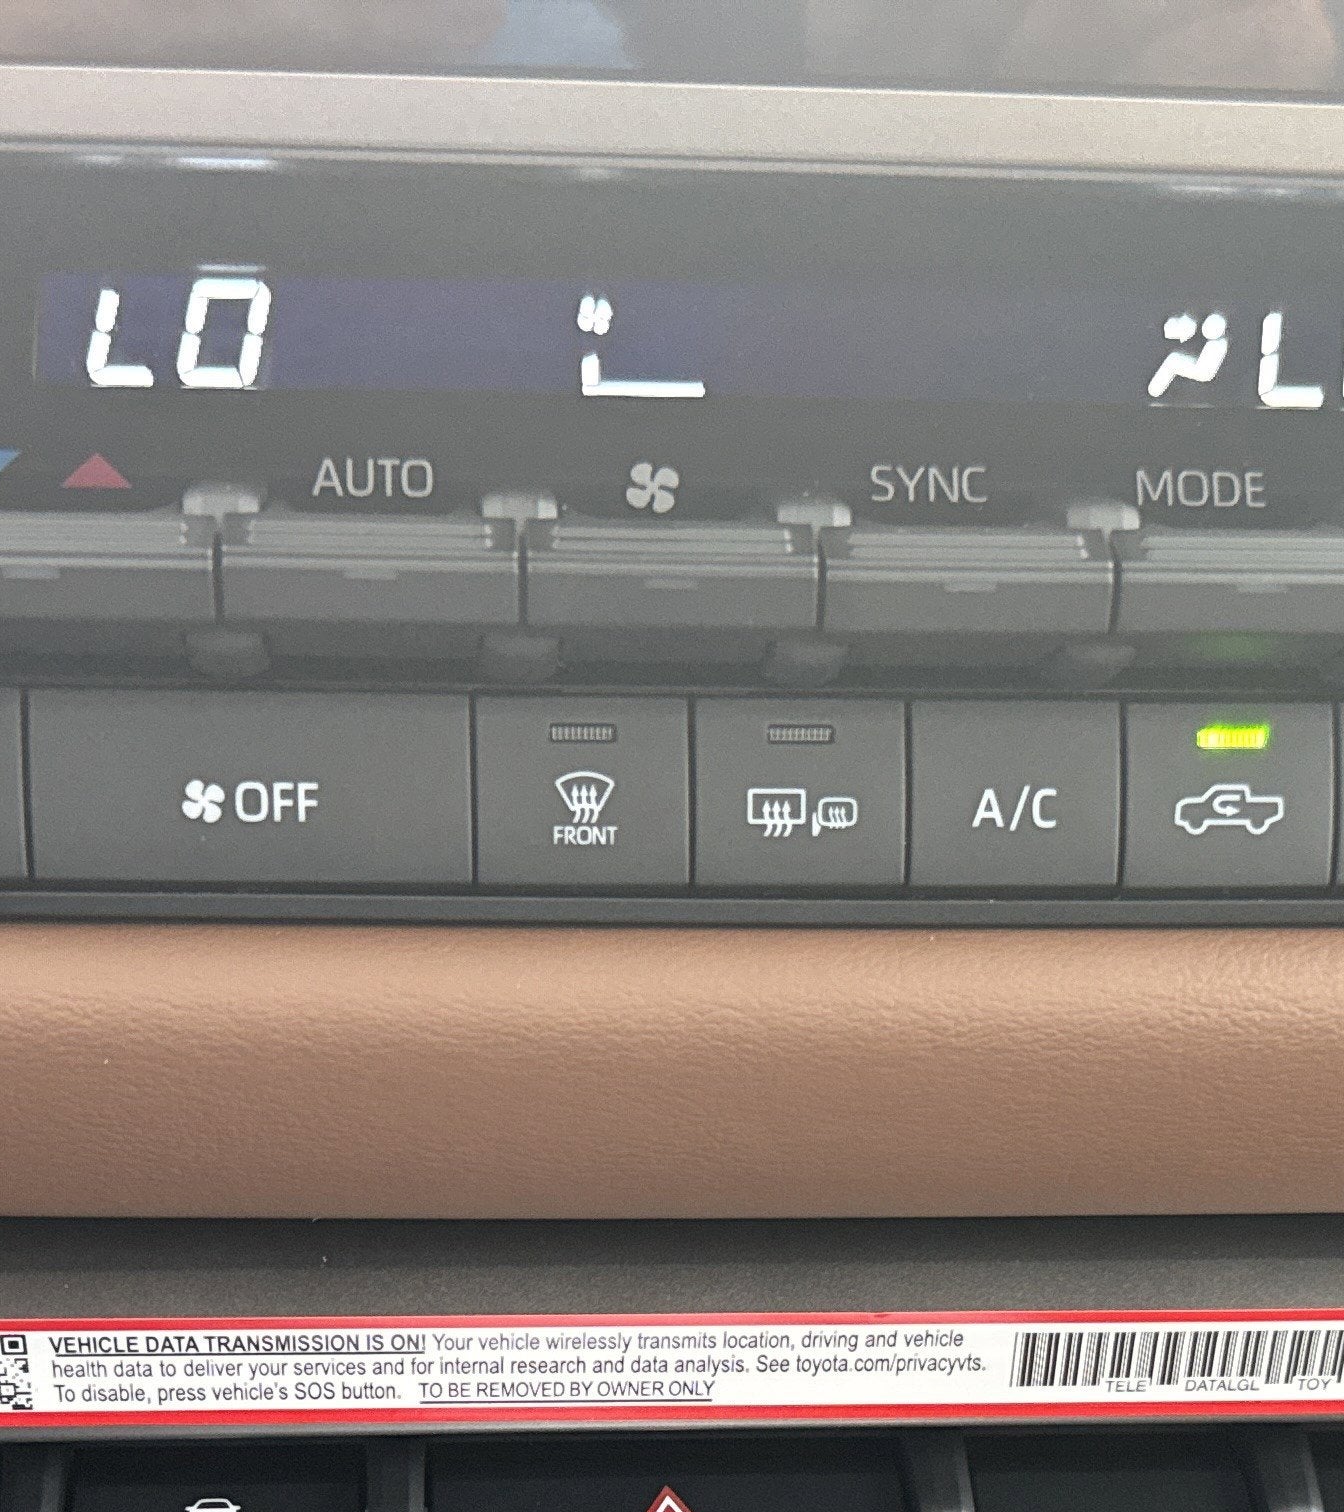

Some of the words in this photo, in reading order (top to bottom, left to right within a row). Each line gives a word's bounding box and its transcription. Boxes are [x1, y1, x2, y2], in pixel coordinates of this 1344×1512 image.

[86, 277, 271, 389] LO
[311, 457, 435, 498] AUTO
[870, 465, 988, 505] SYNC
[1135, 470, 1268, 509] MODE
[234, 781, 319, 824] OFF
[972, 783, 1058, 832] A/C
[552, 825, 618, 846] FRONT
[48, 1336, 139, 1353] VEHICLE
[146, 1336, 199, 1352] DATA
[203, 1335, 359, 1352] TRANSMISSION
[366, 1334, 384, 1351] IS
[391, 1334, 426, 1351] ON!
[432, 1334, 473, 1350] Your
[479, 1333, 540, 1350] vehicle
[545, 1332, 632, 1353] wirelessly
[638, 1331, 717, 1349] transmits
[723, 1331, 795, 1351] location,
[801, 1331, 858, 1351] driving
[865, 1330, 898, 1347] and
[904, 1330, 964, 1347] vehicle
[52, 1361, 107, 1378] health
[114, 1361, 153, 1377] data
[160, 1361, 177, 1377] to
[183, 1359, 243, 1376] deliver
[249, 1362, 288, 1380] your
[293, 1359, 366, 1375] services
[373, 1358, 404, 1375] and
[411, 1357, 434, 1374] for
[440, 1357, 504, 1374] internal
[511, 1356, 586, 1374] research
[593, 1356, 624, 1373] and
[631, 1355, 668, 1373] data
[674, 1355, 750, 1377] analysis.
[756, 1355, 790, 1372] See
[796, 1353, 986, 1377] toyota.com/privacyvts.
[54, 1384, 75, 1402] To
[81, 1384, 151, 1404] disable,
[158, 1387, 206, 1405] press
[212, 1382, 288, 1401] vehicle's
[295, 1382, 335, 1399] SOS
[342, 1382, 402, 1399] button.
[419, 1383, 442, 1398] TO
[448, 1383, 471, 1397] BE
[477, 1382, 565, 1397] REMOVED
[570, 1381, 593, 1397] BY
[597, 1381, 664, 1396] OWNER
[669, 1380, 715, 1396] ONLY
[1105, 1380, 1147, 1392] TELE
[1298, 1378, 1331, 1390] TOY
